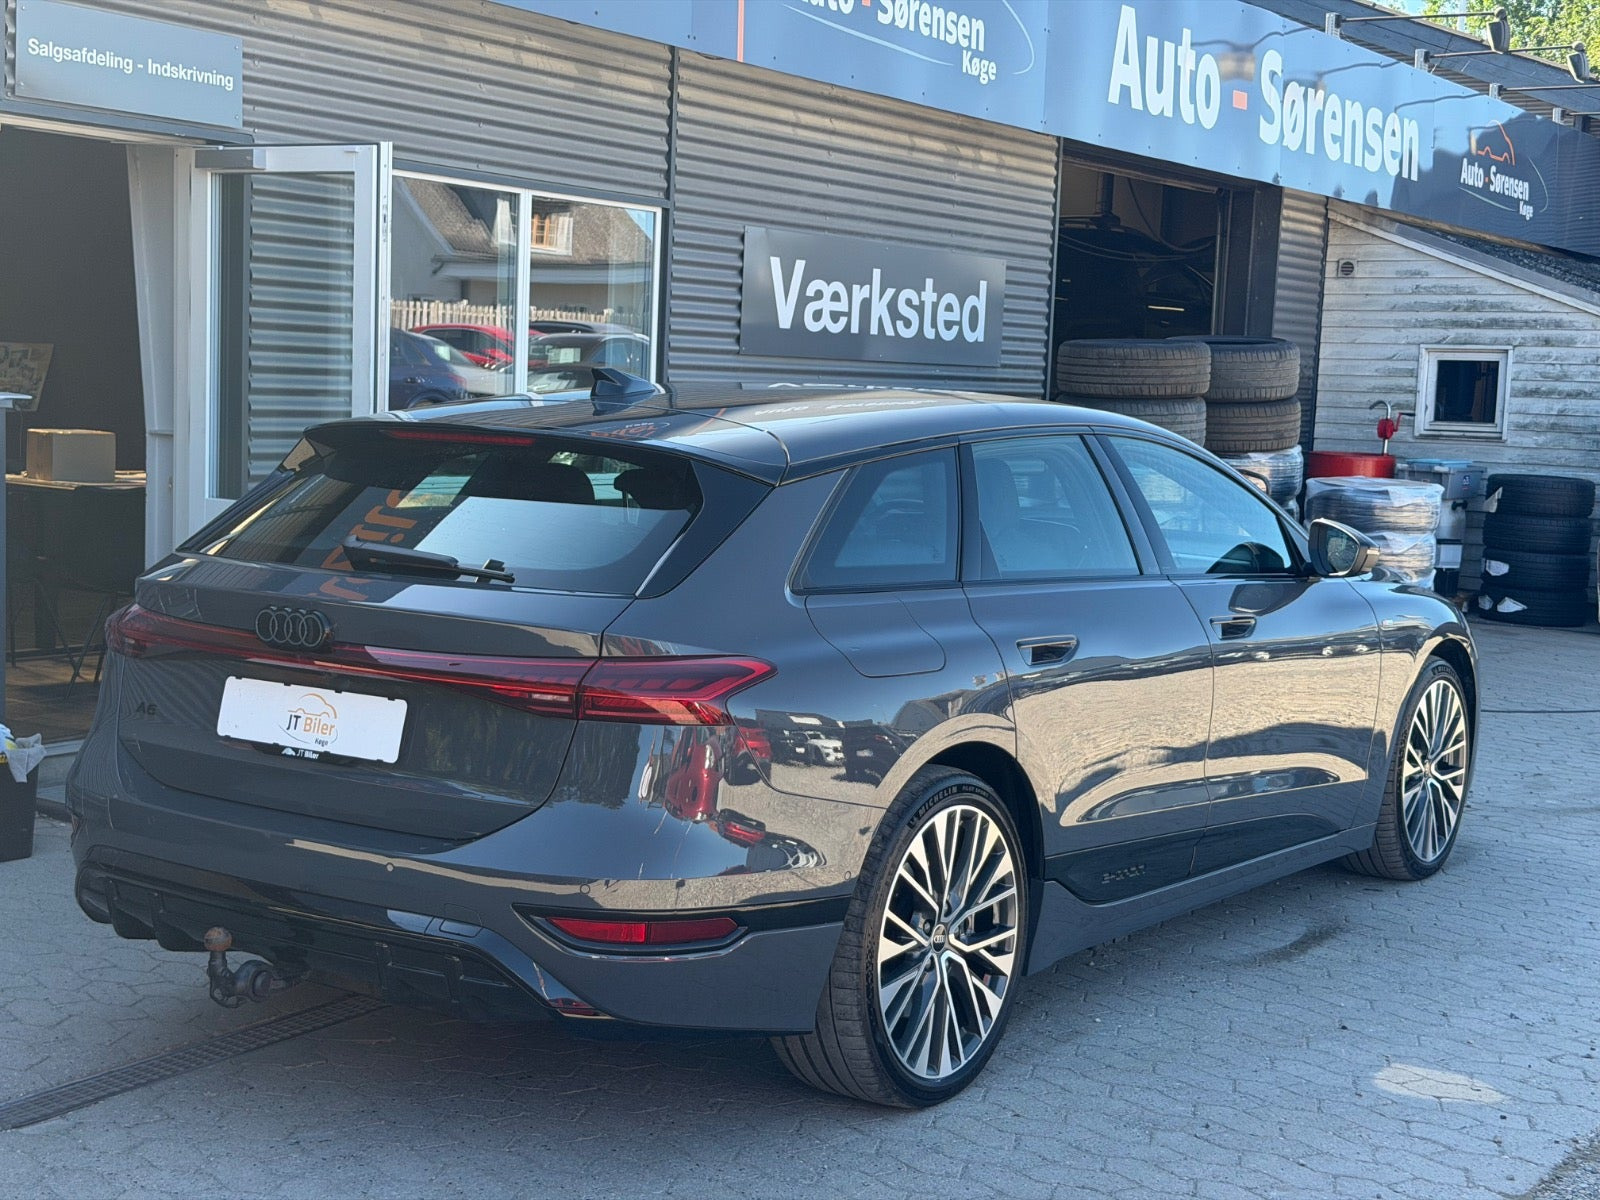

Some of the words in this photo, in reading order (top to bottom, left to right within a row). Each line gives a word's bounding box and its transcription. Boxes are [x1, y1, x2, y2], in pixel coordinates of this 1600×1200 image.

[877, 0, 985, 52] Sørensen
[27, 37, 134, 75] Salgsafdeling
[148, 58, 234, 91] Indskrivning
[961, 50, 998, 84] Køge
[1107, 3, 1221, 130] Auto
[1259, 49, 1419, 182] Sørensen
[1460, 157, 1484, 188] Auto
[769, 255, 988, 343] Værksted
[136, 701, 158, 716] A6
[286, 713, 302, 731] JT
[303, 716, 335, 736] Biler
[918, 785, 958, 818] MICHELIN
